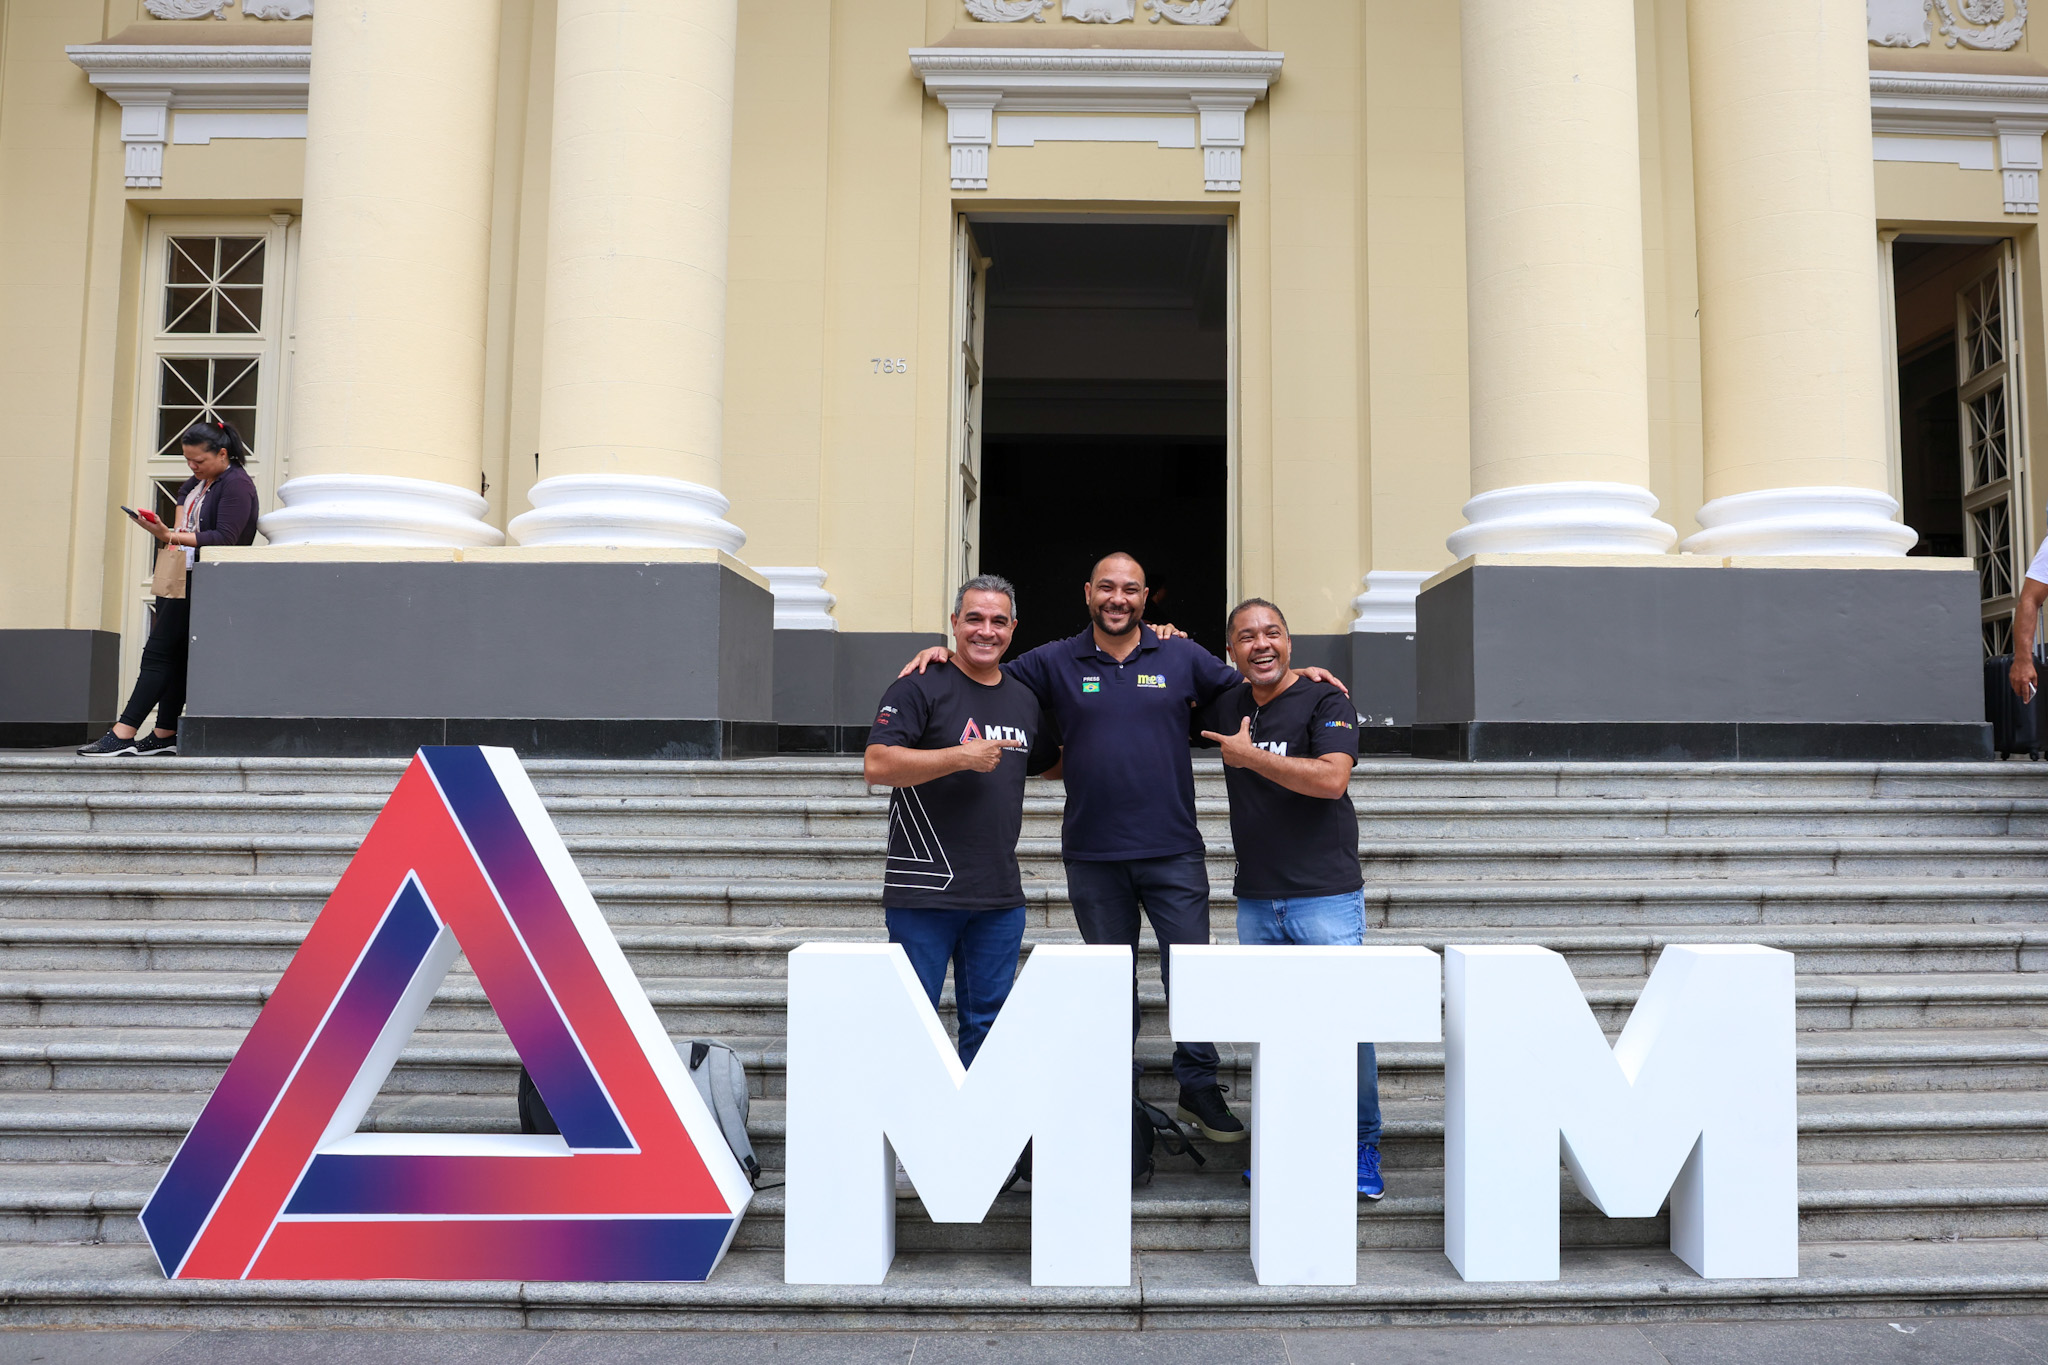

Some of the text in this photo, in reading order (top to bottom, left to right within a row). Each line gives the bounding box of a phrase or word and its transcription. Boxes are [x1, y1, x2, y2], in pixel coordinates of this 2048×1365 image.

[870, 358, 907, 374] 785
[984, 724, 1029, 747] MTM
[1252, 741, 1288, 757] TM
[785, 943, 1799, 1287] MTM
